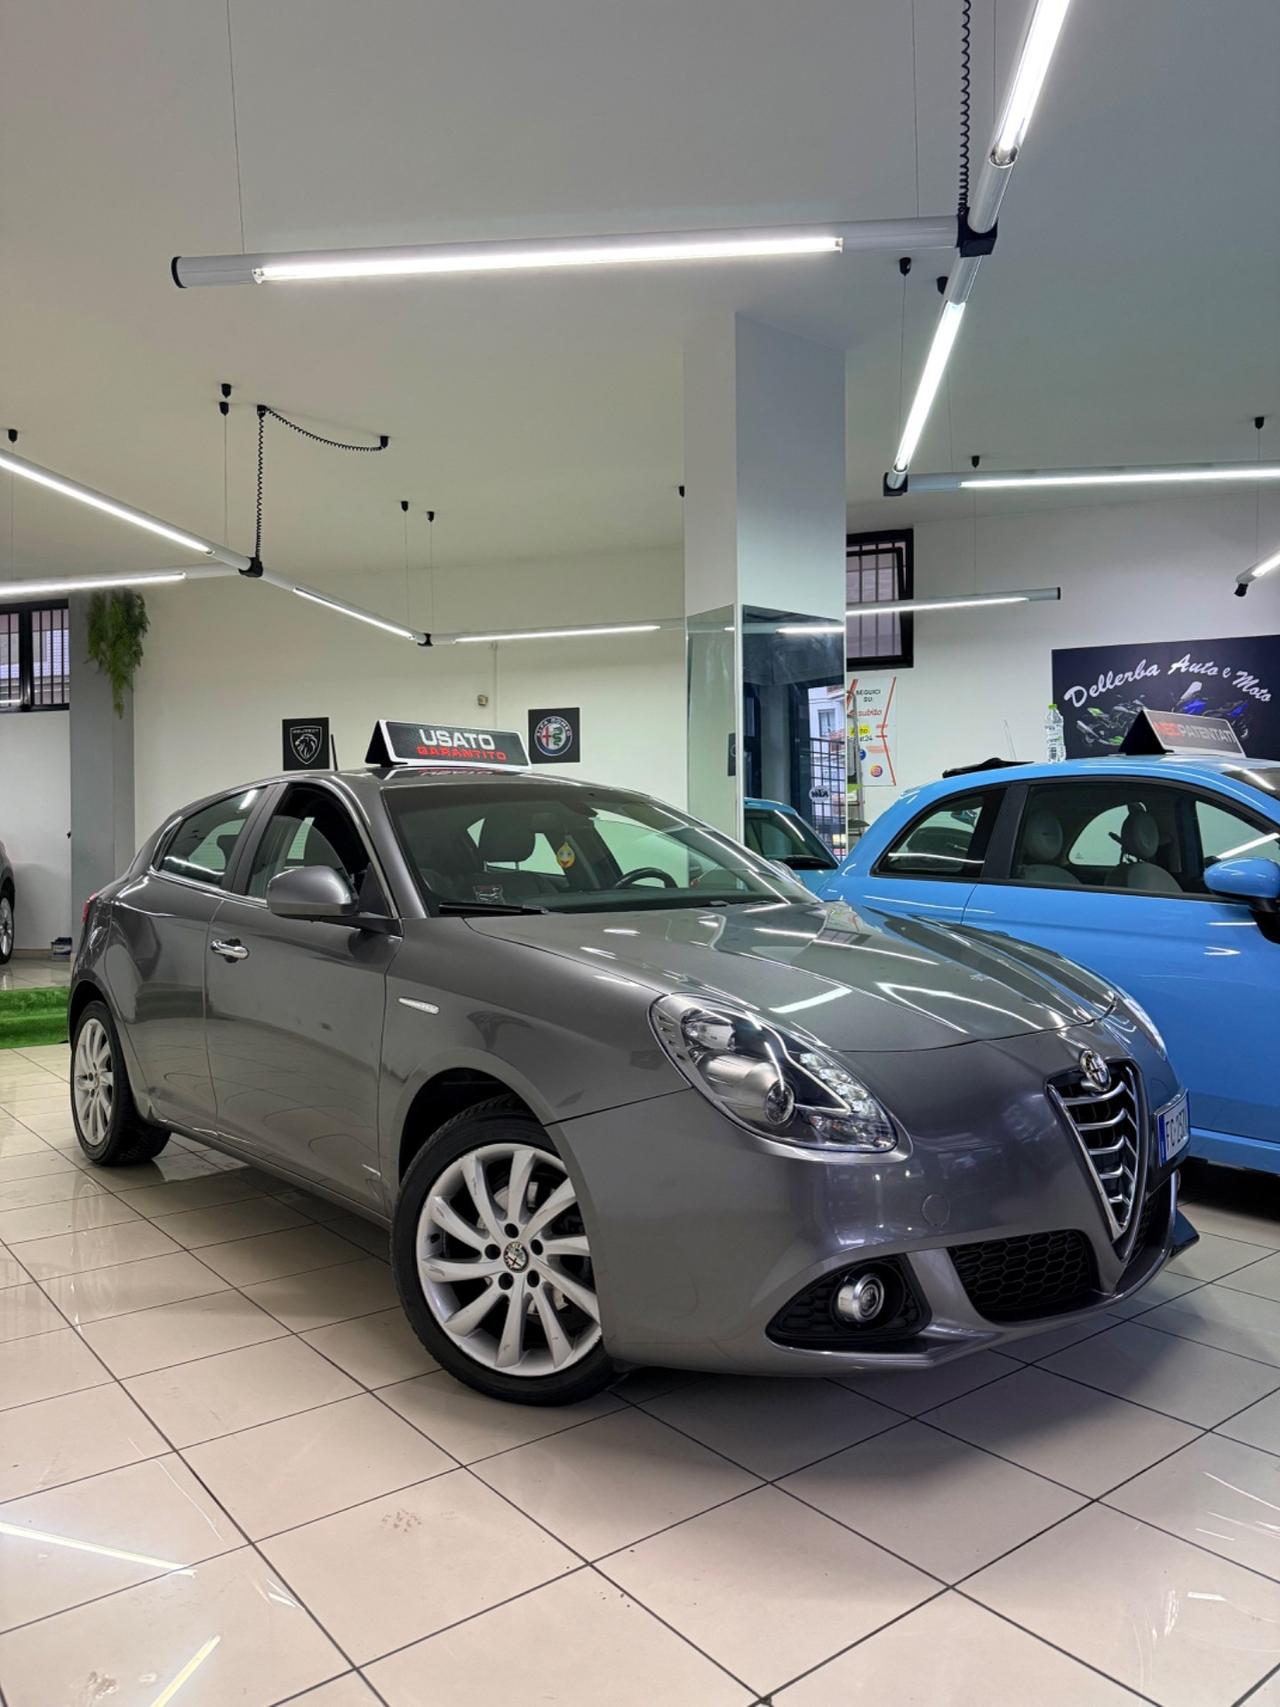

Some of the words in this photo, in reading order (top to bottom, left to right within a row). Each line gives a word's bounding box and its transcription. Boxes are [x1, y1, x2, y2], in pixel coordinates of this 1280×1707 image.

[1064, 659, 1160, 707] Dellerba
[1168, 653, 1218, 676] Auto
[1222, 667, 1231, 678] e
[1233, 671, 1272, 702] Moto
[419, 729, 495, 750] USATO
[417, 744, 507, 761] GARANTITO
